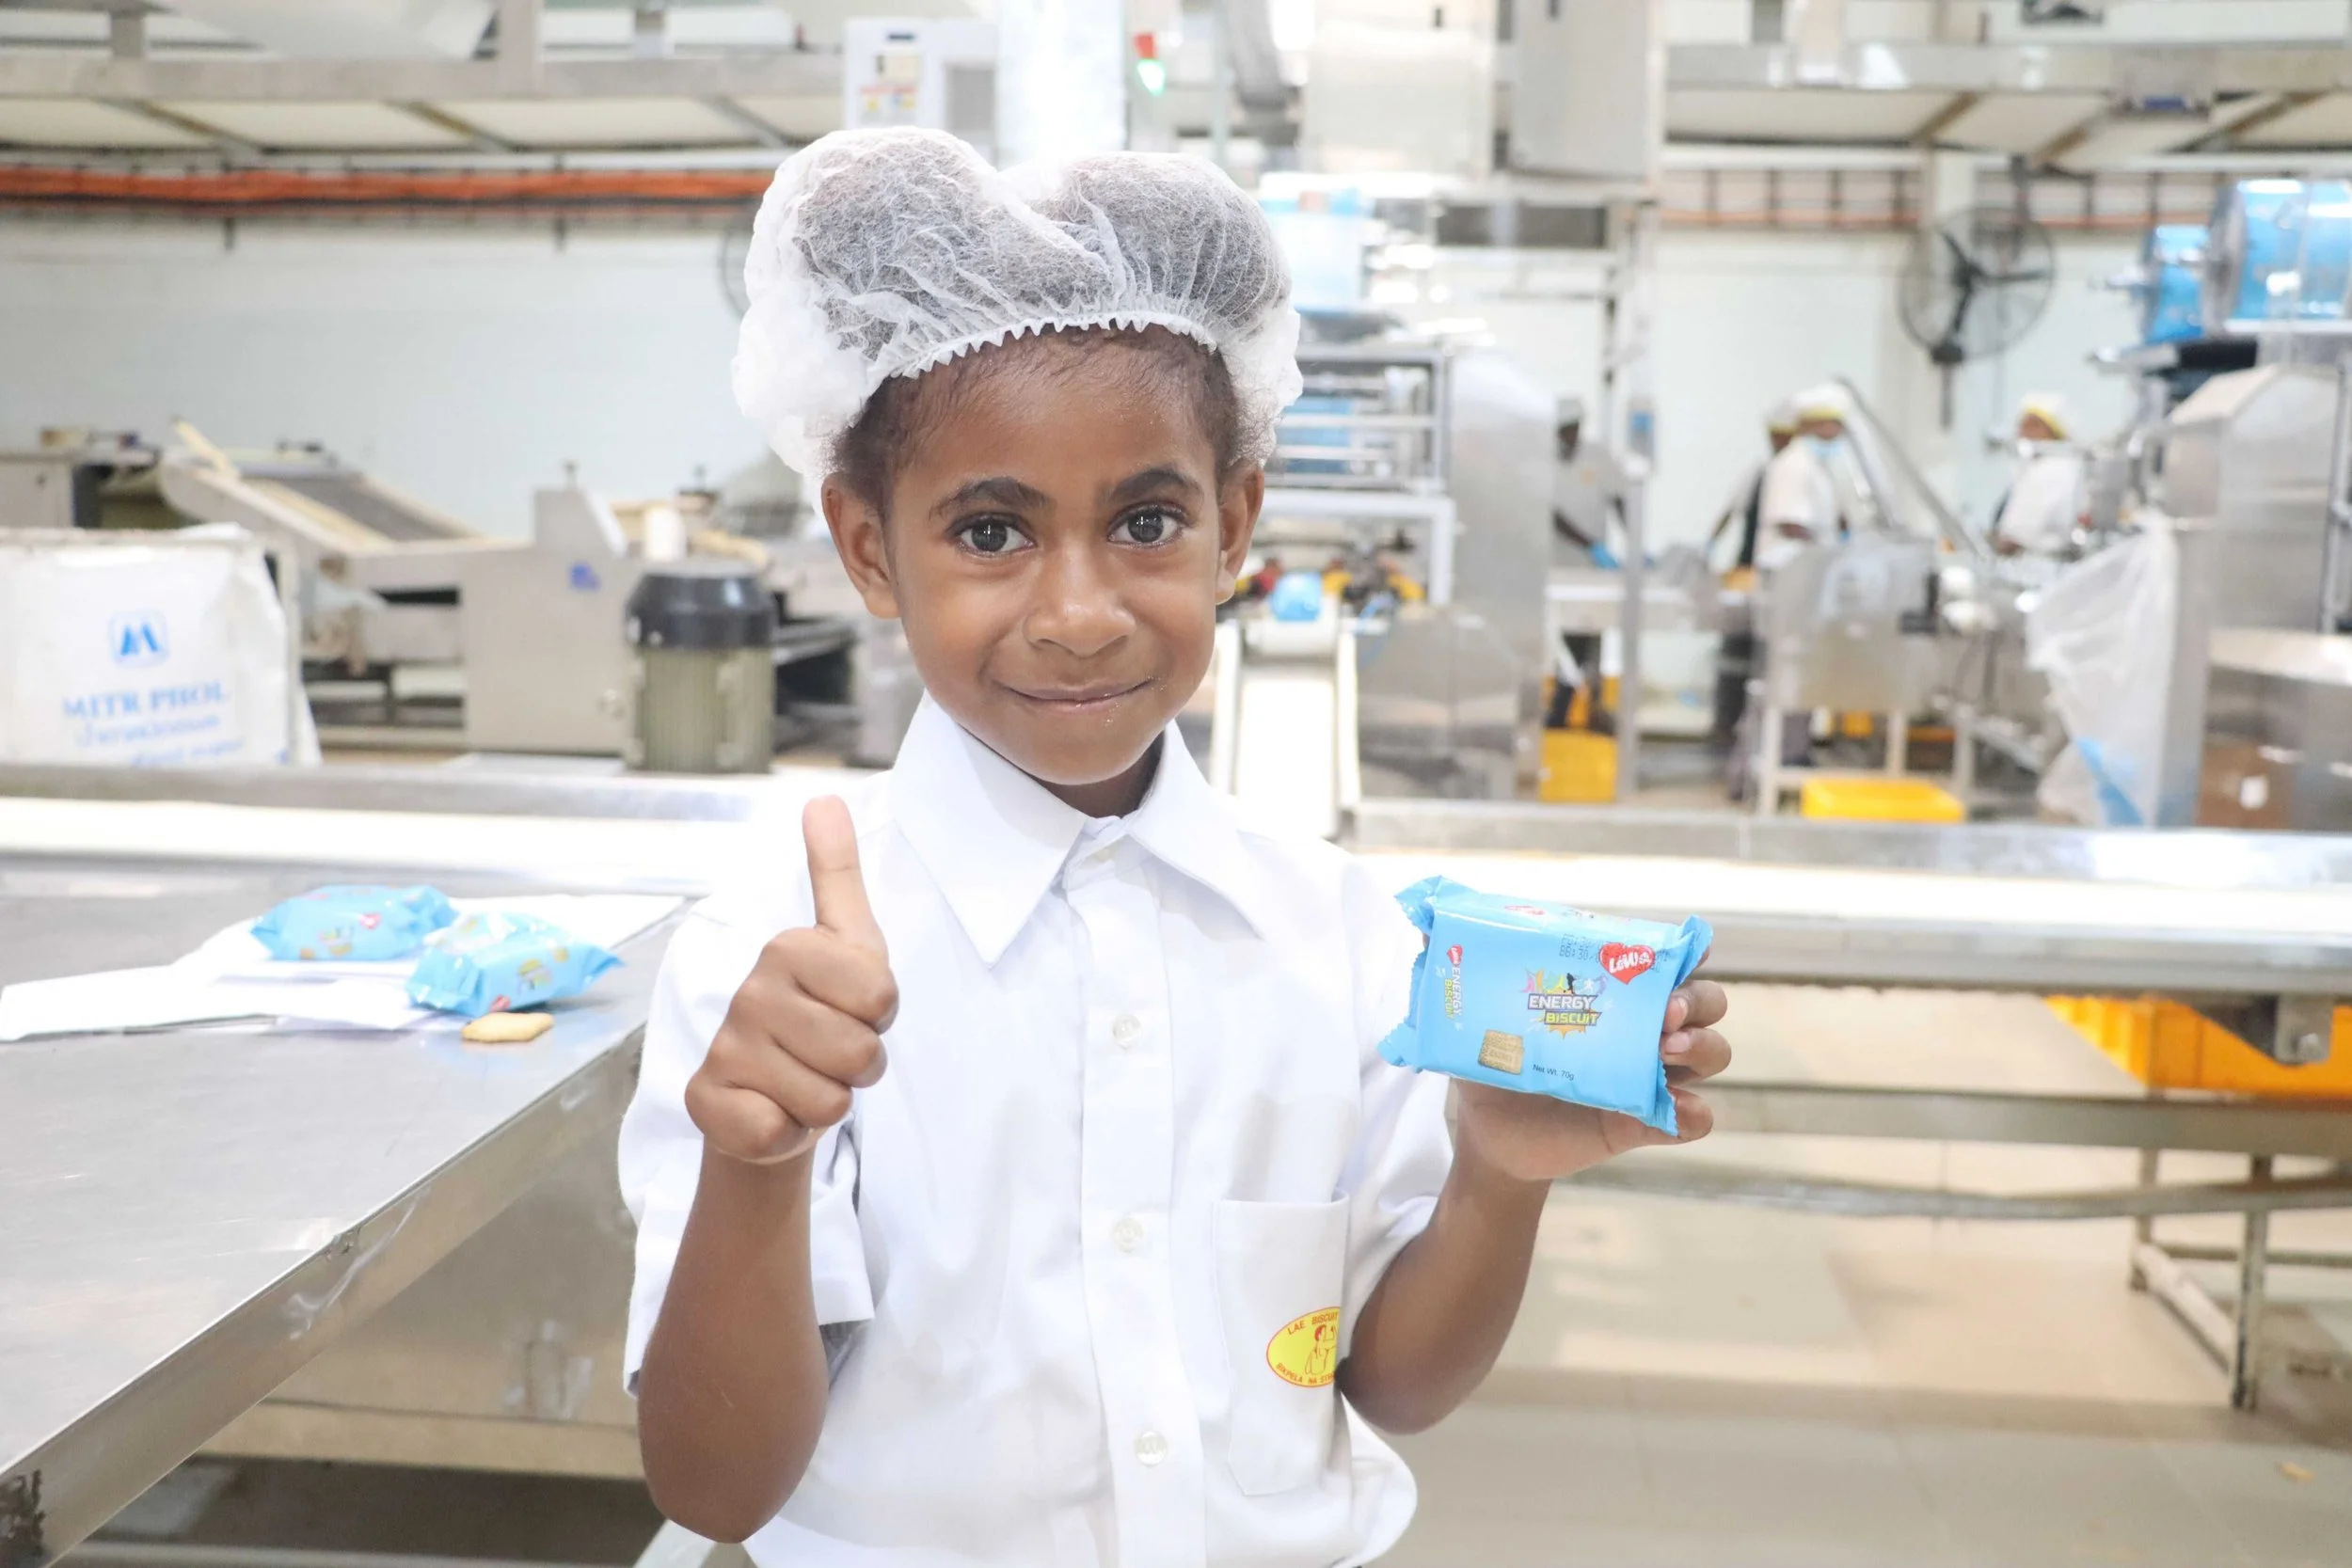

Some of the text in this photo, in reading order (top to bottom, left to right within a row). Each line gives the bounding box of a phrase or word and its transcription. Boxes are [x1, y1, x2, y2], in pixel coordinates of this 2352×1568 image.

[1452, 967, 1462, 1016] ENERGY
[1528, 994, 1597, 1009] ENERGY
[1545, 1012, 1600, 1024] BISCUIT
[1533, 1064, 1545, 1073] Net
[1561, 1070, 1575, 1081] 70g
[1287, 1320, 1305, 1335] LAE
